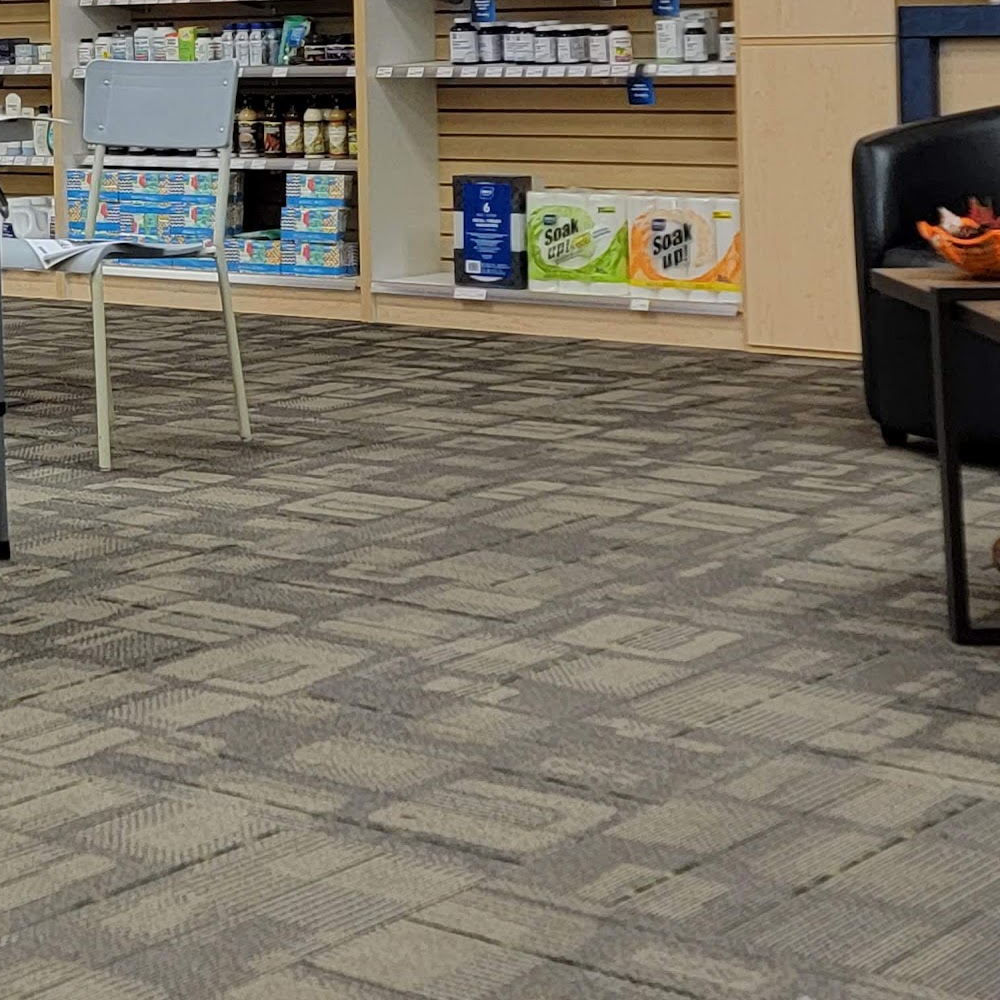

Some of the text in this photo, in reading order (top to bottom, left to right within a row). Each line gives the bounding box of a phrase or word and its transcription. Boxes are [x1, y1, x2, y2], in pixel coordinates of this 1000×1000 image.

[483, 202, 491, 213] 6
[544, 218, 579, 247] Soak
[652, 222, 693, 256] Soak
[547, 240, 570, 260] up!
[662, 245, 688, 270] up!
